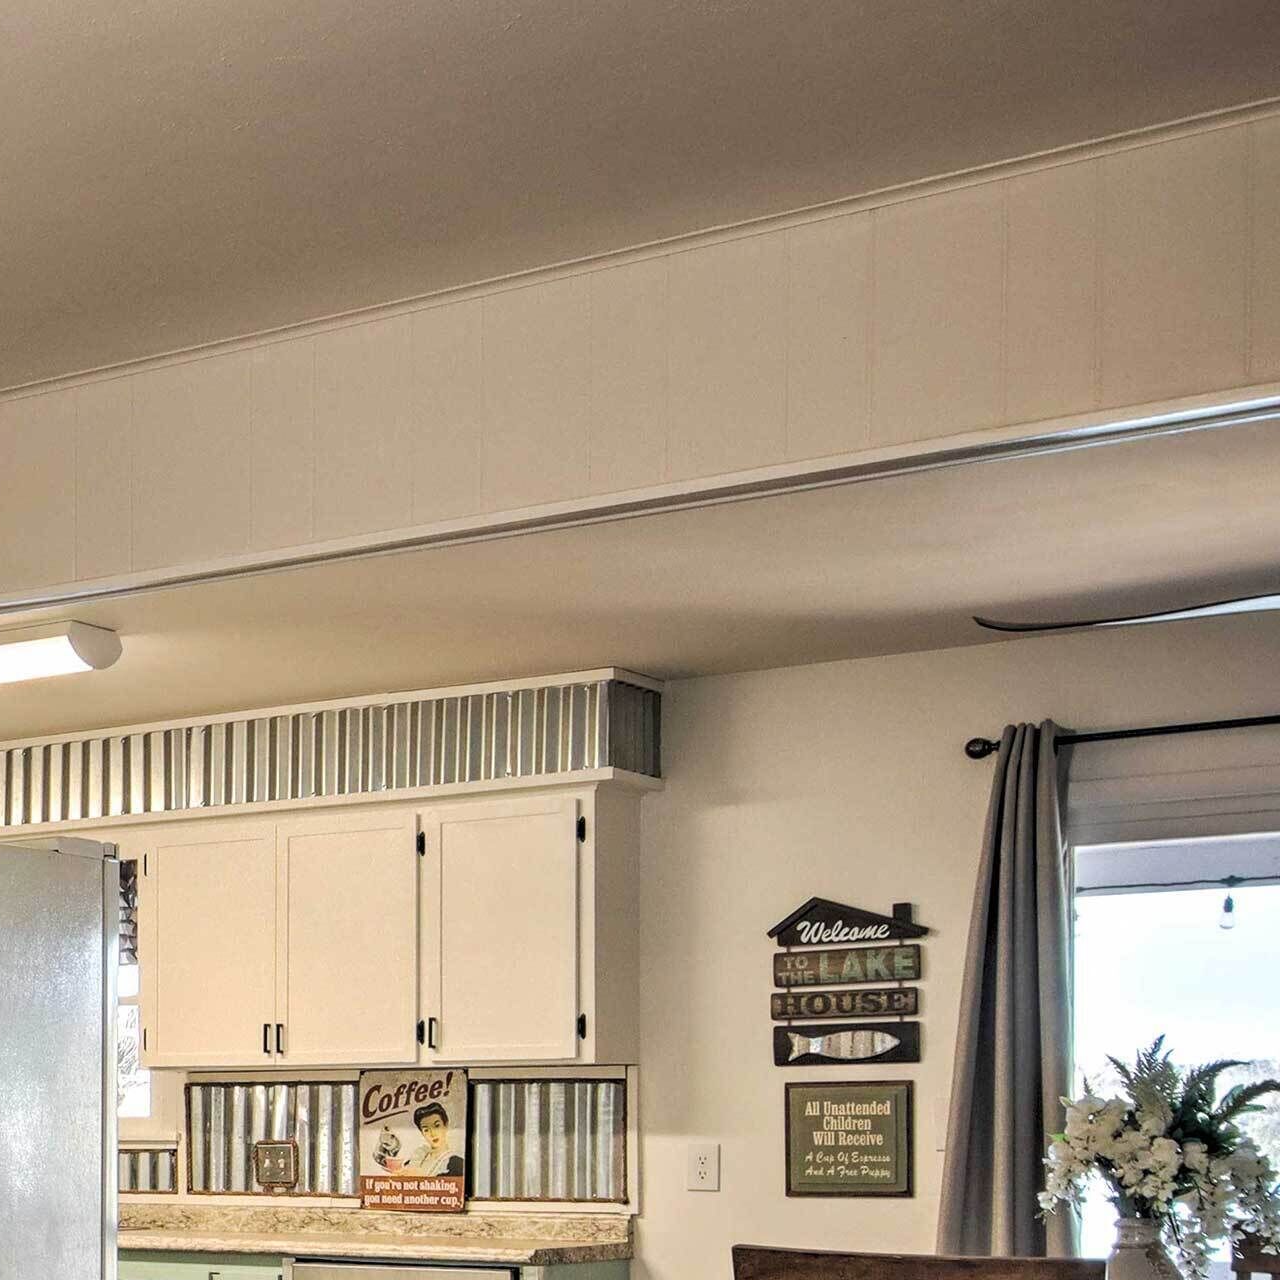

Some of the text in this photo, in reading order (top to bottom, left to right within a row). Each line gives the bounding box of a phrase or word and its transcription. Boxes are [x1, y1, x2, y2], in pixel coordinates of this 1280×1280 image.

[796, 920, 890, 944] Welcome
[784, 956, 808, 969] TO
[818, 947, 915, 983] LAKE
[778, 970, 815, 984] THE
[776, 991, 909, 1015] HOUSE
[362, 1071, 453, 1118] Coffee!
[805, 1100, 891, 1116] All Unattended
[823, 1116, 872, 1131] Children
[813, 1131, 884, 1146] Will Receive
[805, 1151, 891, 1165] A Cup Of Espresso
[805, 1165, 890, 1178] And A Free Puppy
[375, 1179, 402, 1192] you're
[403, 1181, 419, 1190] not
[364, 1194, 380, 1206] you
[382, 1194, 403, 1204] need
[404, 1194, 440, 1205] another
